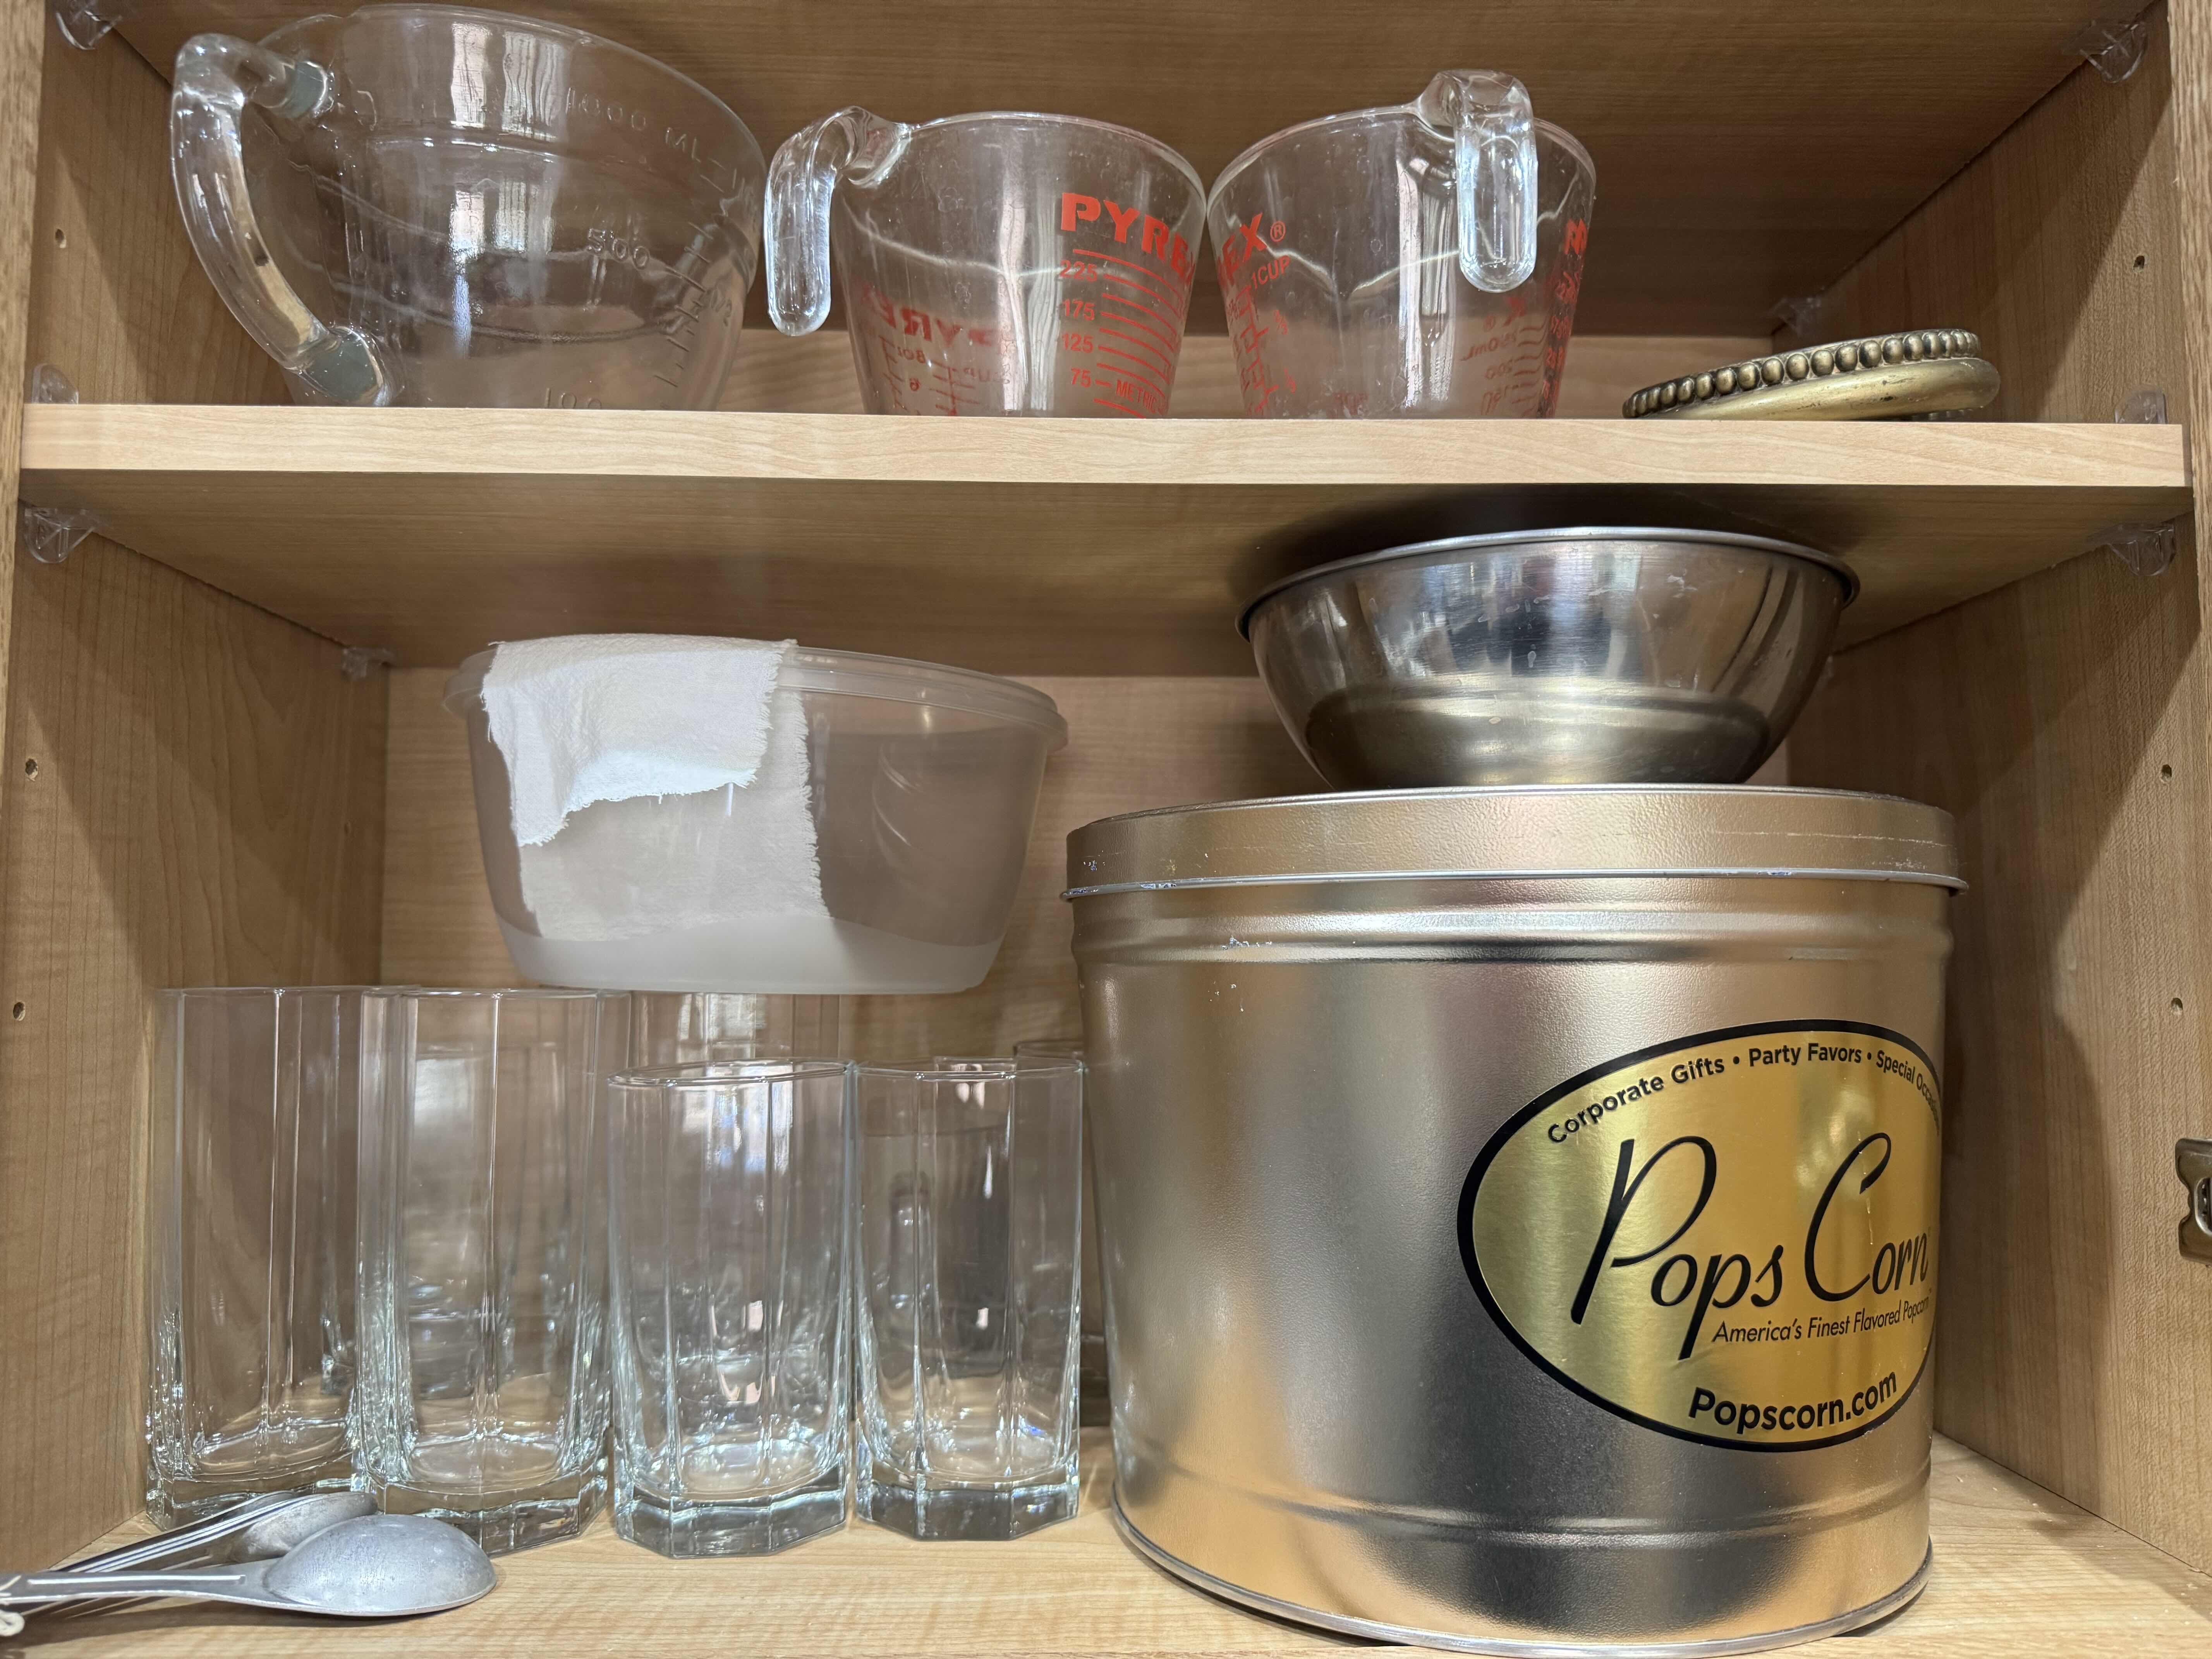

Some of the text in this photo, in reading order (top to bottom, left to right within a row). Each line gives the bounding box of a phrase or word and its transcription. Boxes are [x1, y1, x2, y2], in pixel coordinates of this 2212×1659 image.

[587, 228, 650, 270] 500
[1061, 192, 1197, 285] PYRE
[1059, 260, 1097, 282] 225
[1063, 298, 1095, 321] 175
[1061, 332, 1094, 353] 125
[1071, 368, 1091, 388] 75
[1548, 1076, 1664, 1143] Corporate
[1671, 1058, 1725, 1084] Gifts
[1749, 1045, 1801, 1067] Party
[1808, 1043, 1862, 1063] Favors
[1876, 1050, 1915, 1084] Special
[1571, 1132, 1928, 1360] Pops Corn
[1711, 1318, 1802, 1342] America's
[1807, 1317, 1850, 1338] Finest
[1853, 1299, 1901, 1333] Flavored
[1688, 1371, 1897, 1434] Popscorn.com
